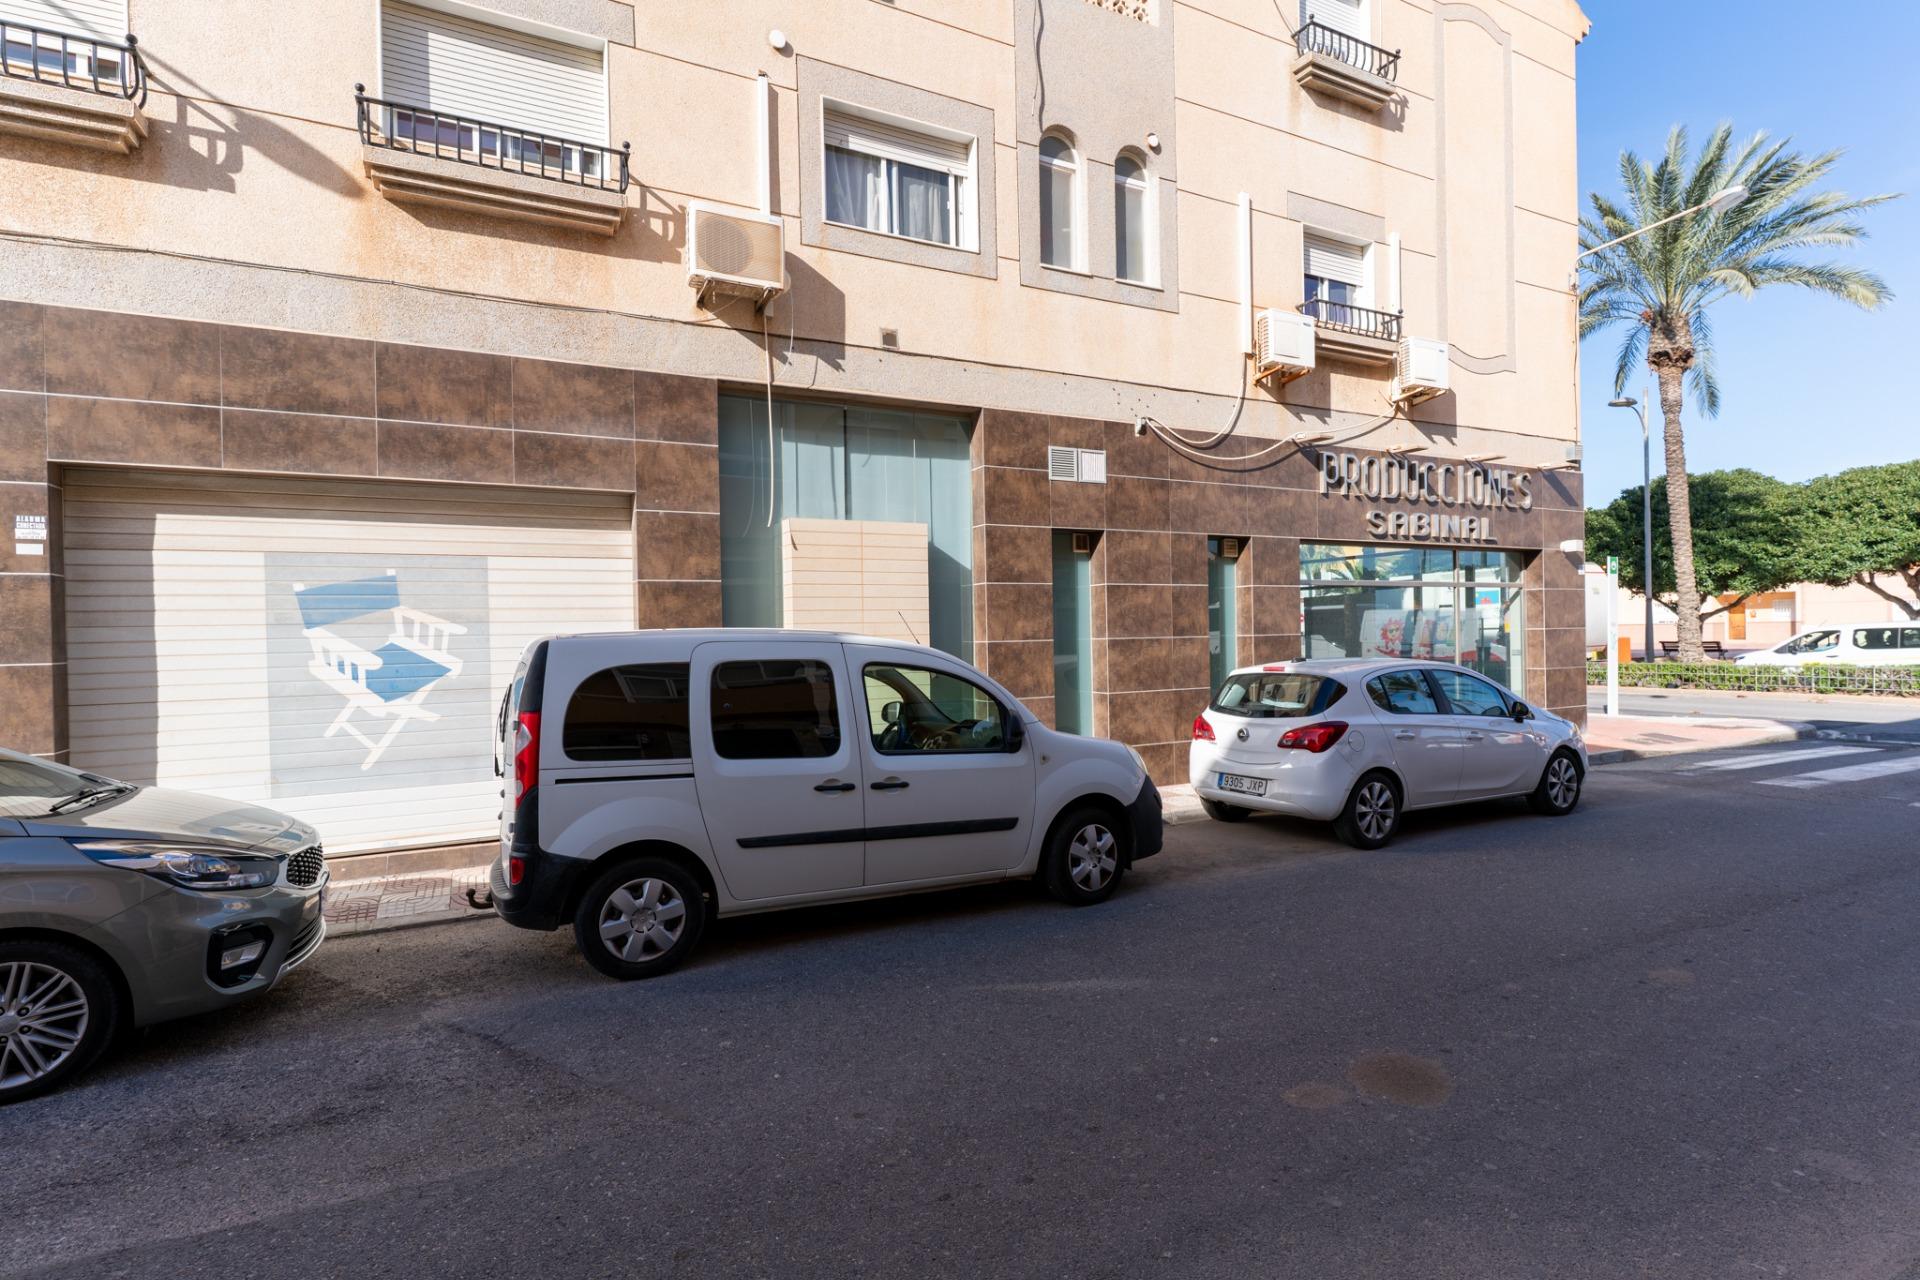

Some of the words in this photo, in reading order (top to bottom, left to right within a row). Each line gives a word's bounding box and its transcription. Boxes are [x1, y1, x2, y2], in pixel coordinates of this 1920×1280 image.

[1319, 451, 1532, 509] PRODUCCIONES
[1366, 511, 1498, 543] SABINAL
[1224, 776, 1243, 788] 9305
[1247, 780, 1263, 791] JXP
